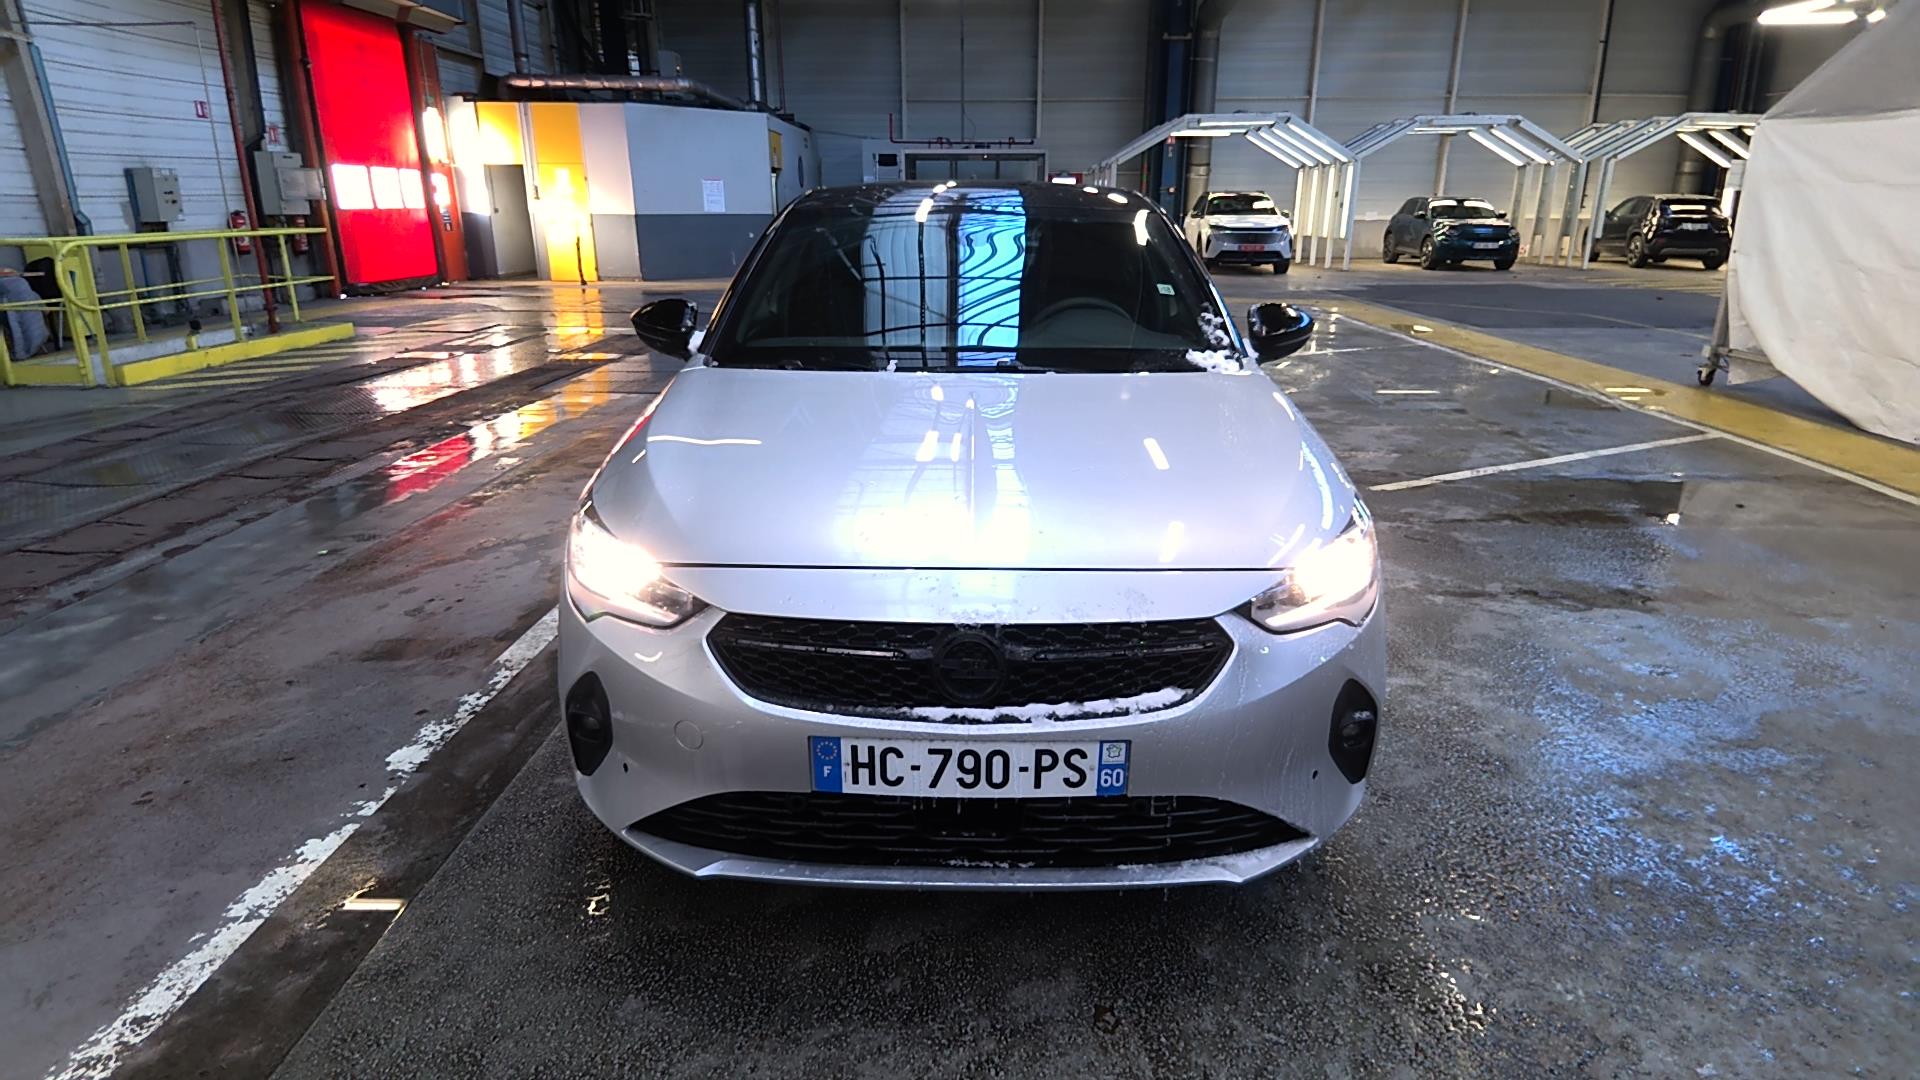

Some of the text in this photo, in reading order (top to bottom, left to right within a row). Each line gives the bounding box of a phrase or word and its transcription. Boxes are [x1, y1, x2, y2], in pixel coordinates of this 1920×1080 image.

[823, 765, 832, 777] F
[850, 745, 1089, 789] HC-790-PS
[1100, 768, 1124, 788] 60
